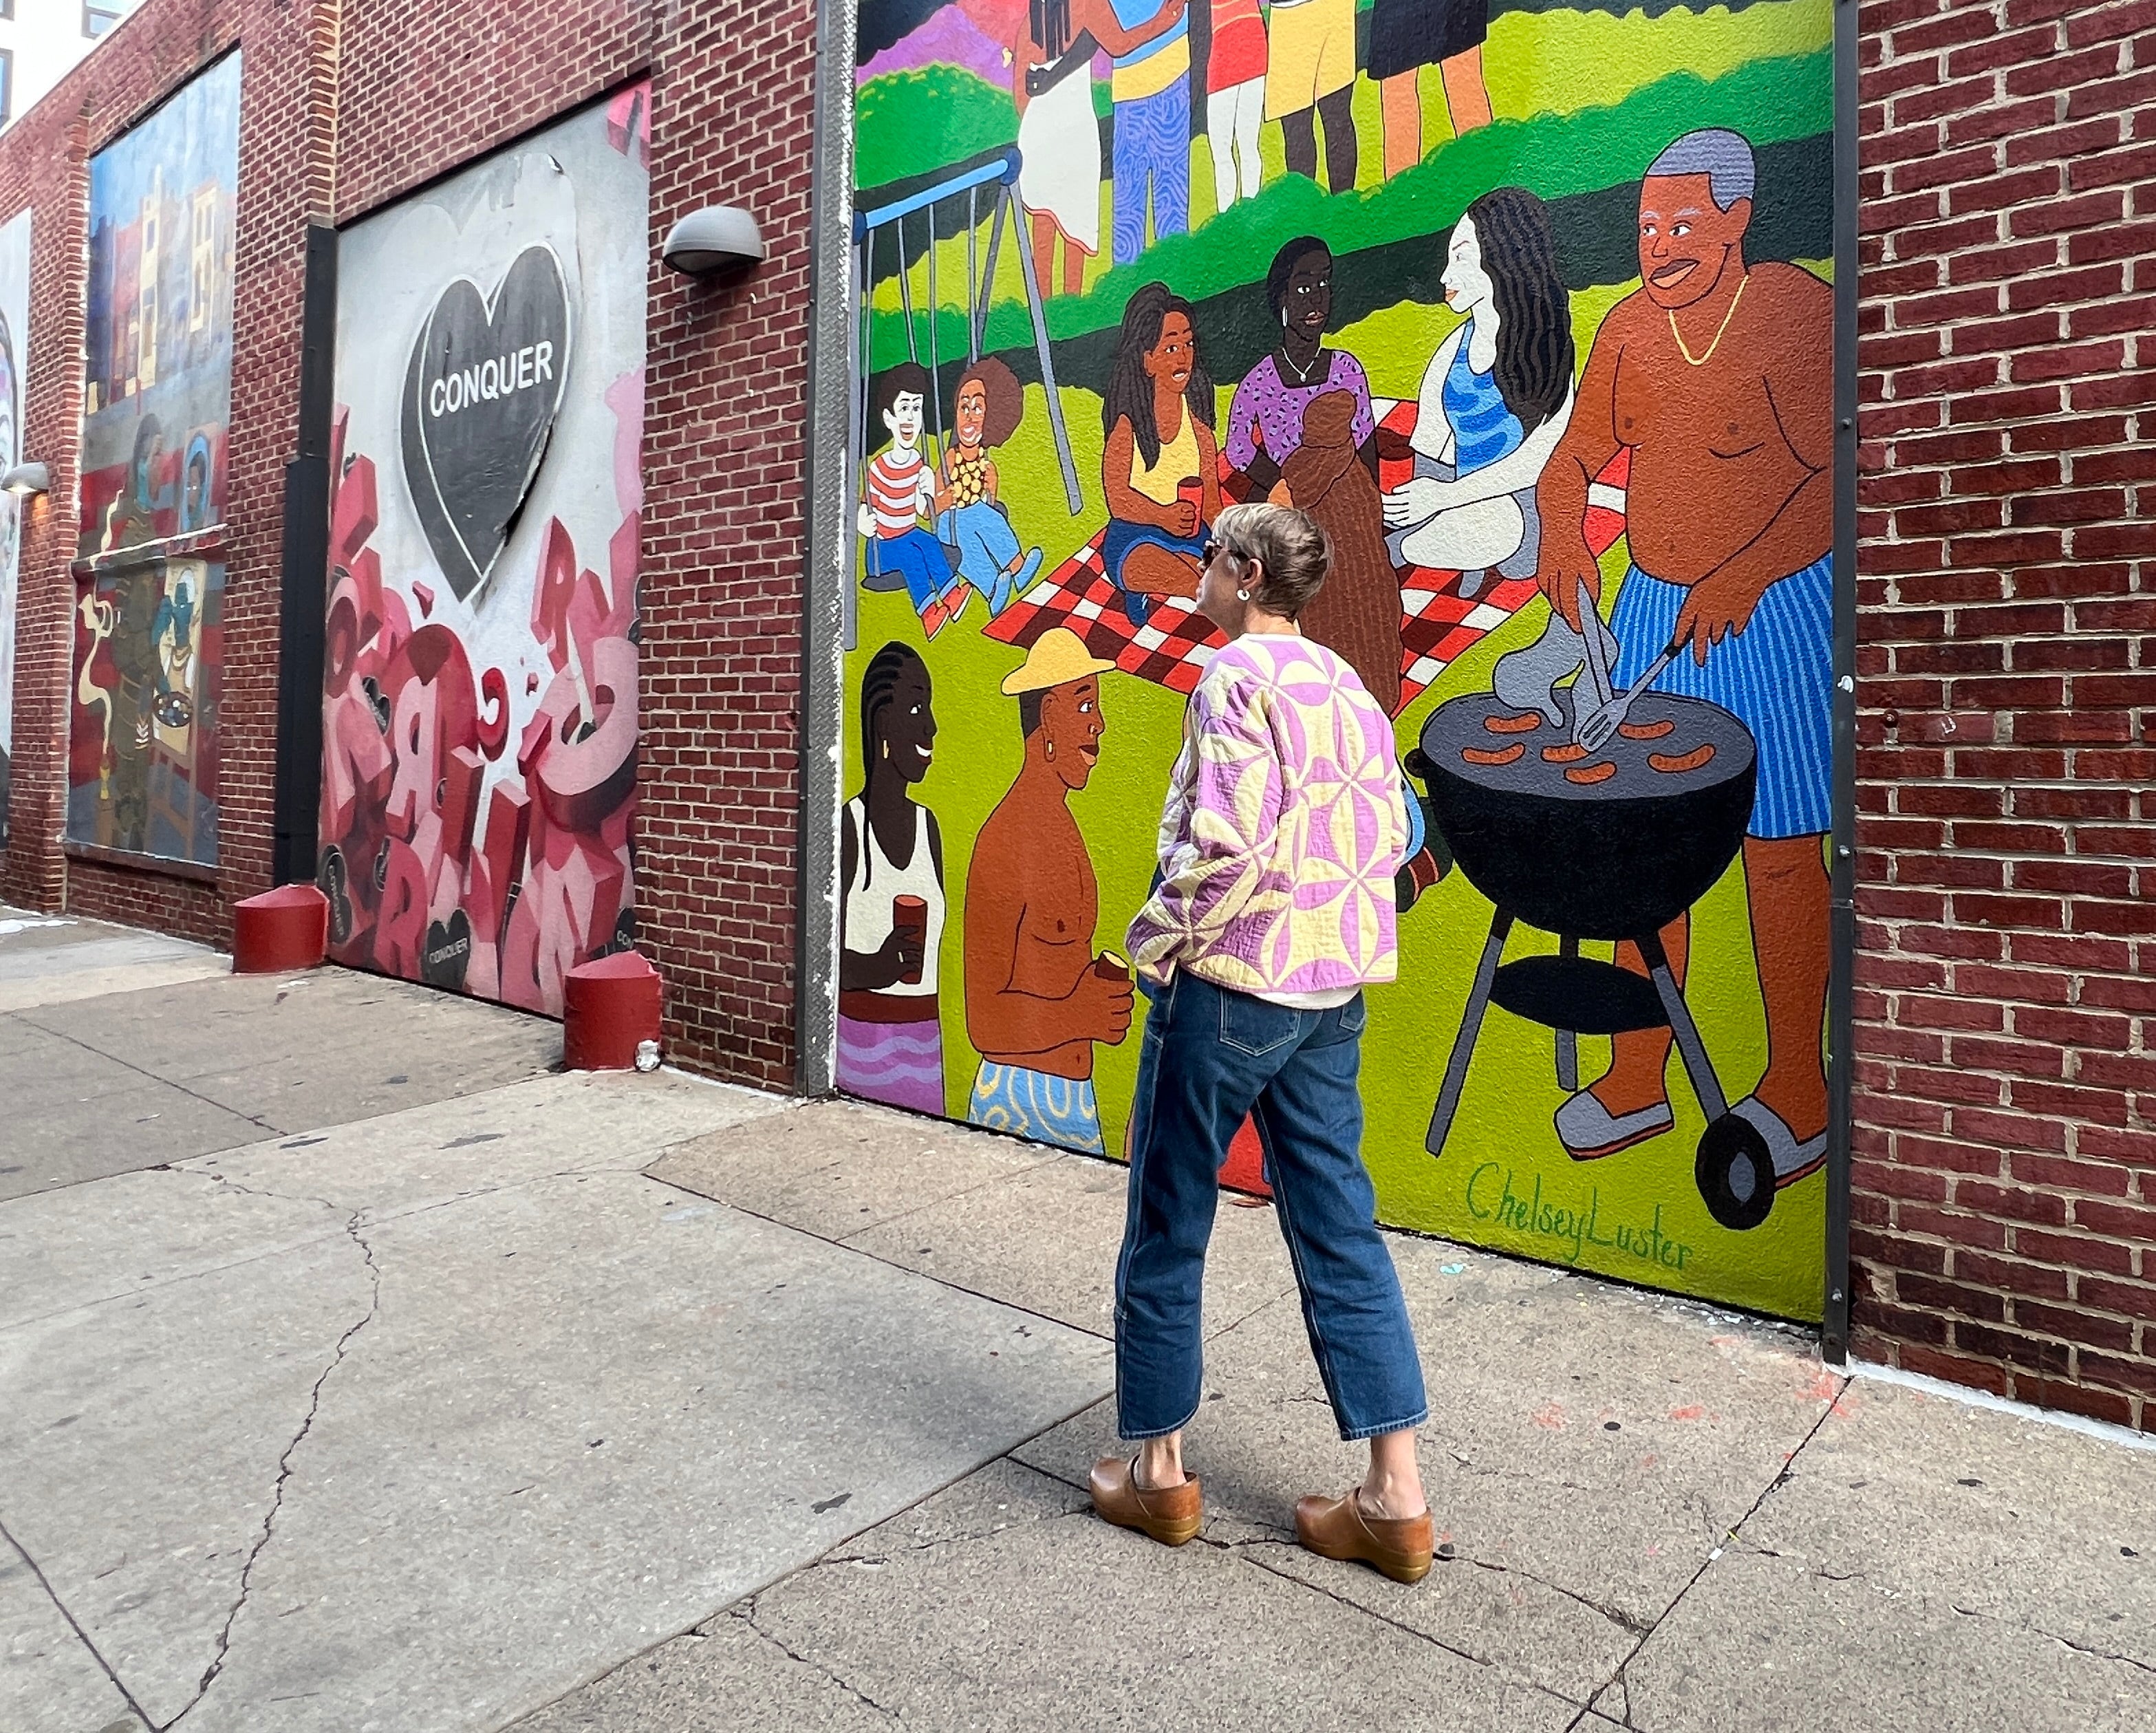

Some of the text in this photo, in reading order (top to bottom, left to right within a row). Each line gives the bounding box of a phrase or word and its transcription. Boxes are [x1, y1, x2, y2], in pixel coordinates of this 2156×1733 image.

[430, 341, 553, 418] CONQUER
[1466, 1162, 1694, 1270] Chelsey Luster
